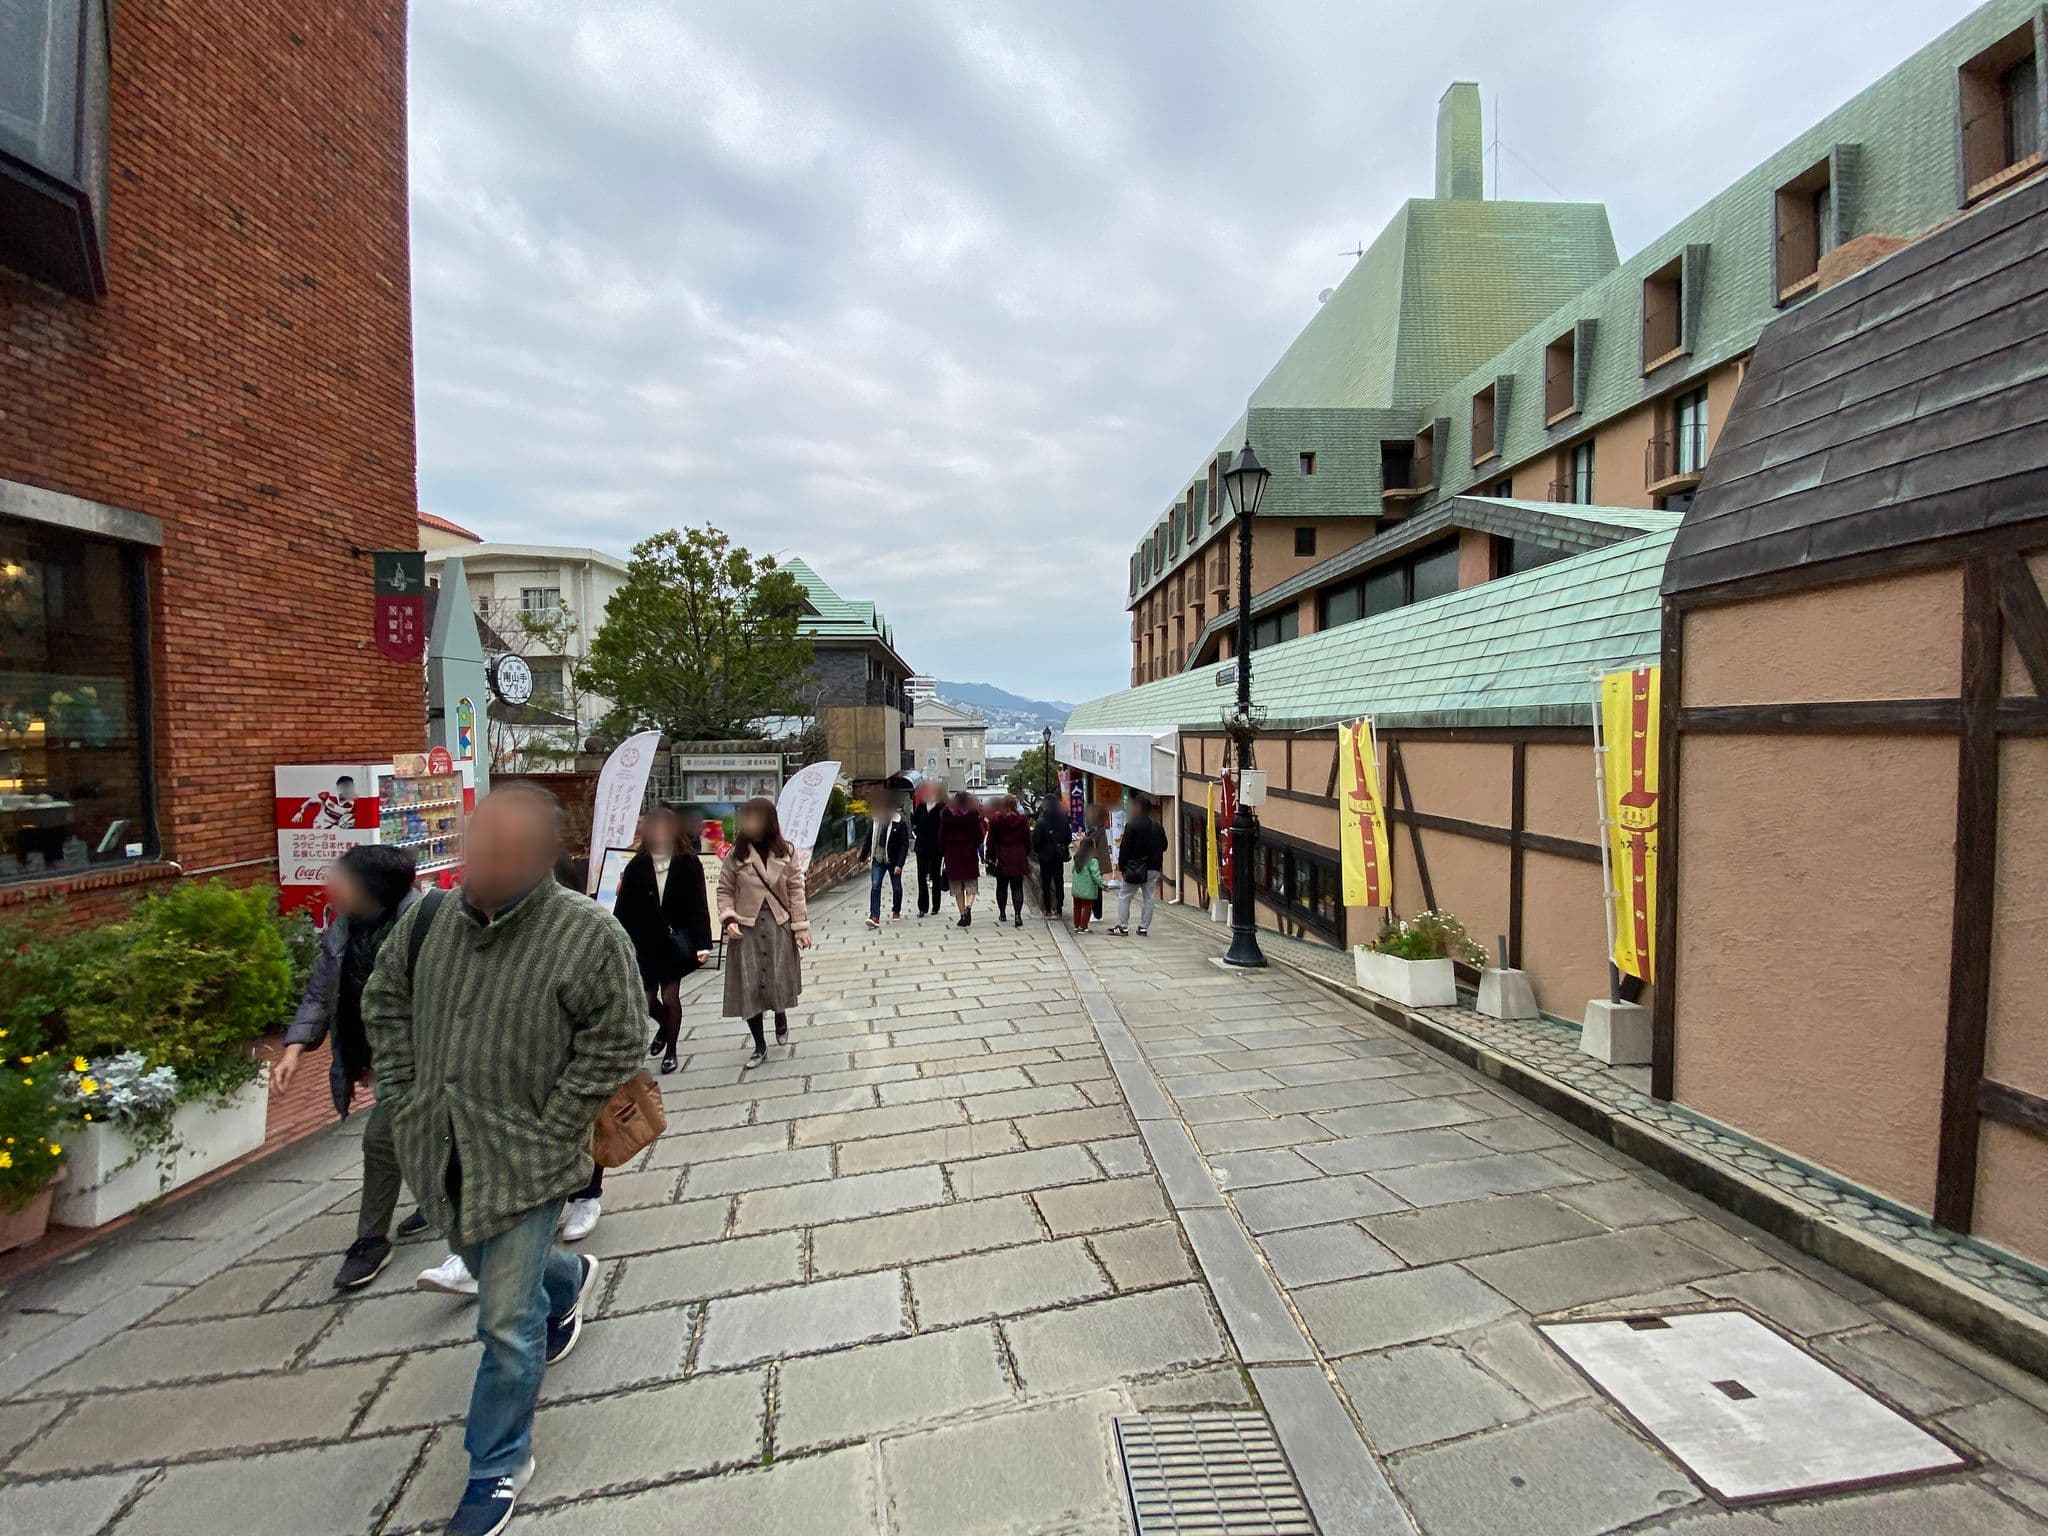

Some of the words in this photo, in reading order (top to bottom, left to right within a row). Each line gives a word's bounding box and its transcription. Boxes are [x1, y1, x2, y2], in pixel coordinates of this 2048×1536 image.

[503, 671, 528, 683] 南山手
[505, 682, 527, 694] プリン
